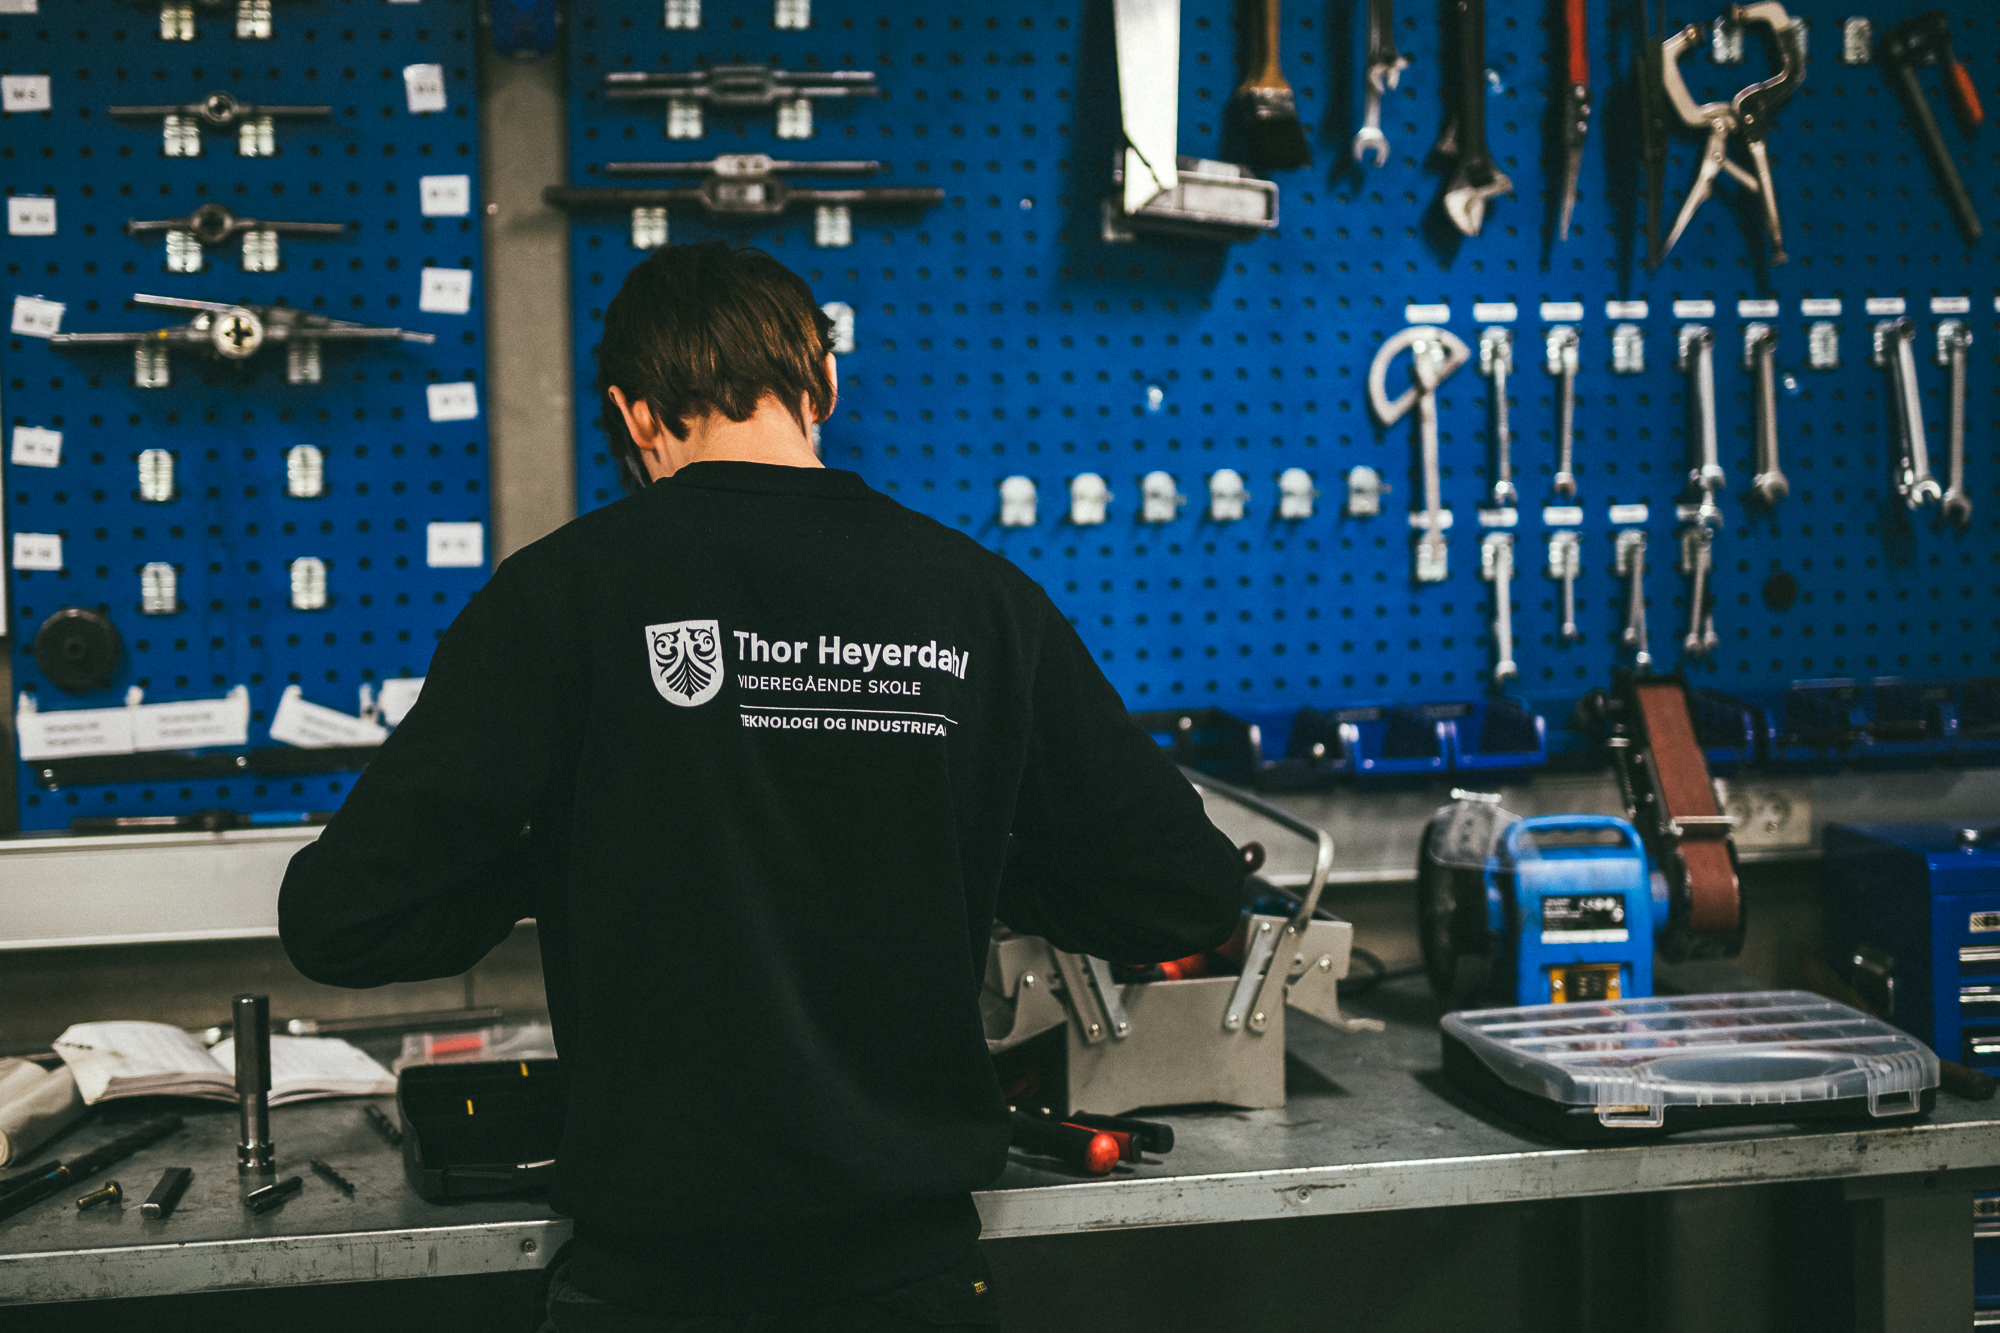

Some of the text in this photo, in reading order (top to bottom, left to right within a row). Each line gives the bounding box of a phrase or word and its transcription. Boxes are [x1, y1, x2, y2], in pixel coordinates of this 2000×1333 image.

[733, 631, 969, 680] Thor Heyerdahl
[738, 674, 922, 696] VIDEREGÅENDE SKOLE
[740, 713, 947, 737] TEKNOLOGI OG INDUSTRIFA
